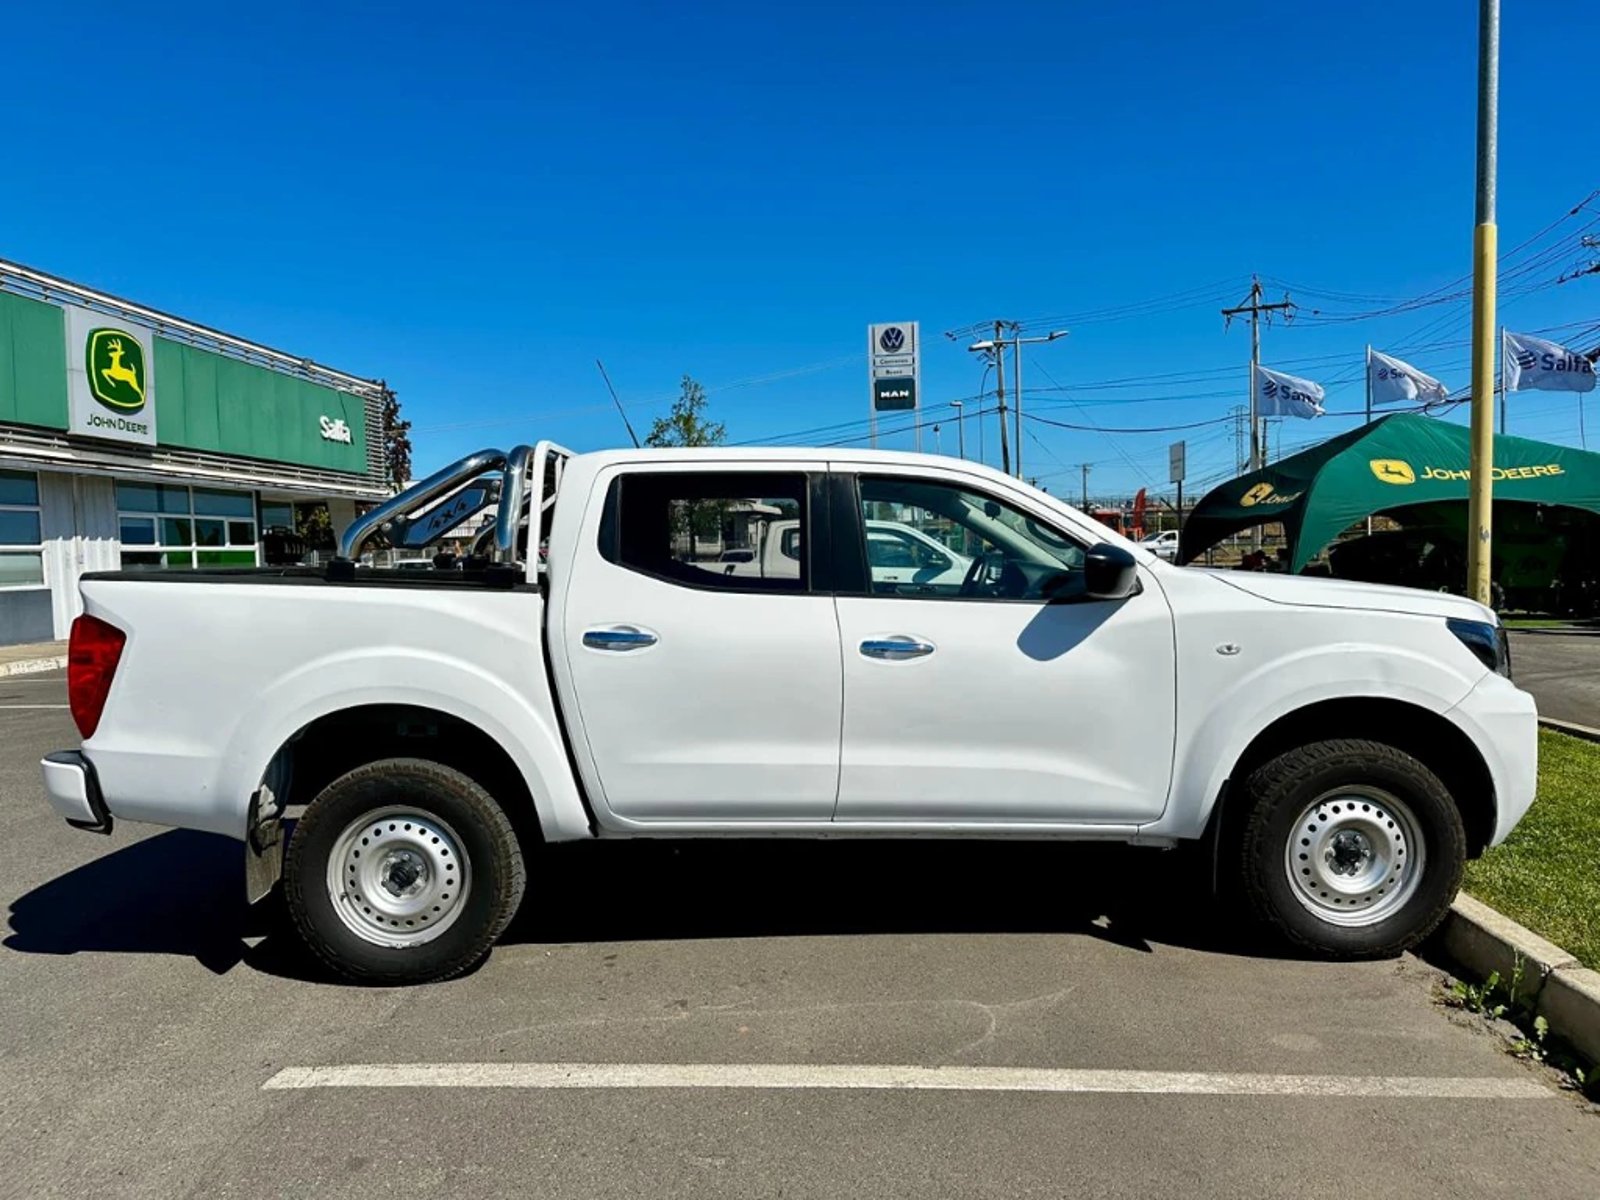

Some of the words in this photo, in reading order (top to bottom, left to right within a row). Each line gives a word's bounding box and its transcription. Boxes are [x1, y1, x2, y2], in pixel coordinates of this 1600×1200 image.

[1541, 353, 1592, 374] Salfa
[880, 390, 909, 398] MAN
[87, 414, 118, 429] JOHN
[118, 418, 148, 435] DEERE
[320, 415, 350, 443] Salfa
[1491, 464, 1565, 480] DEERE
